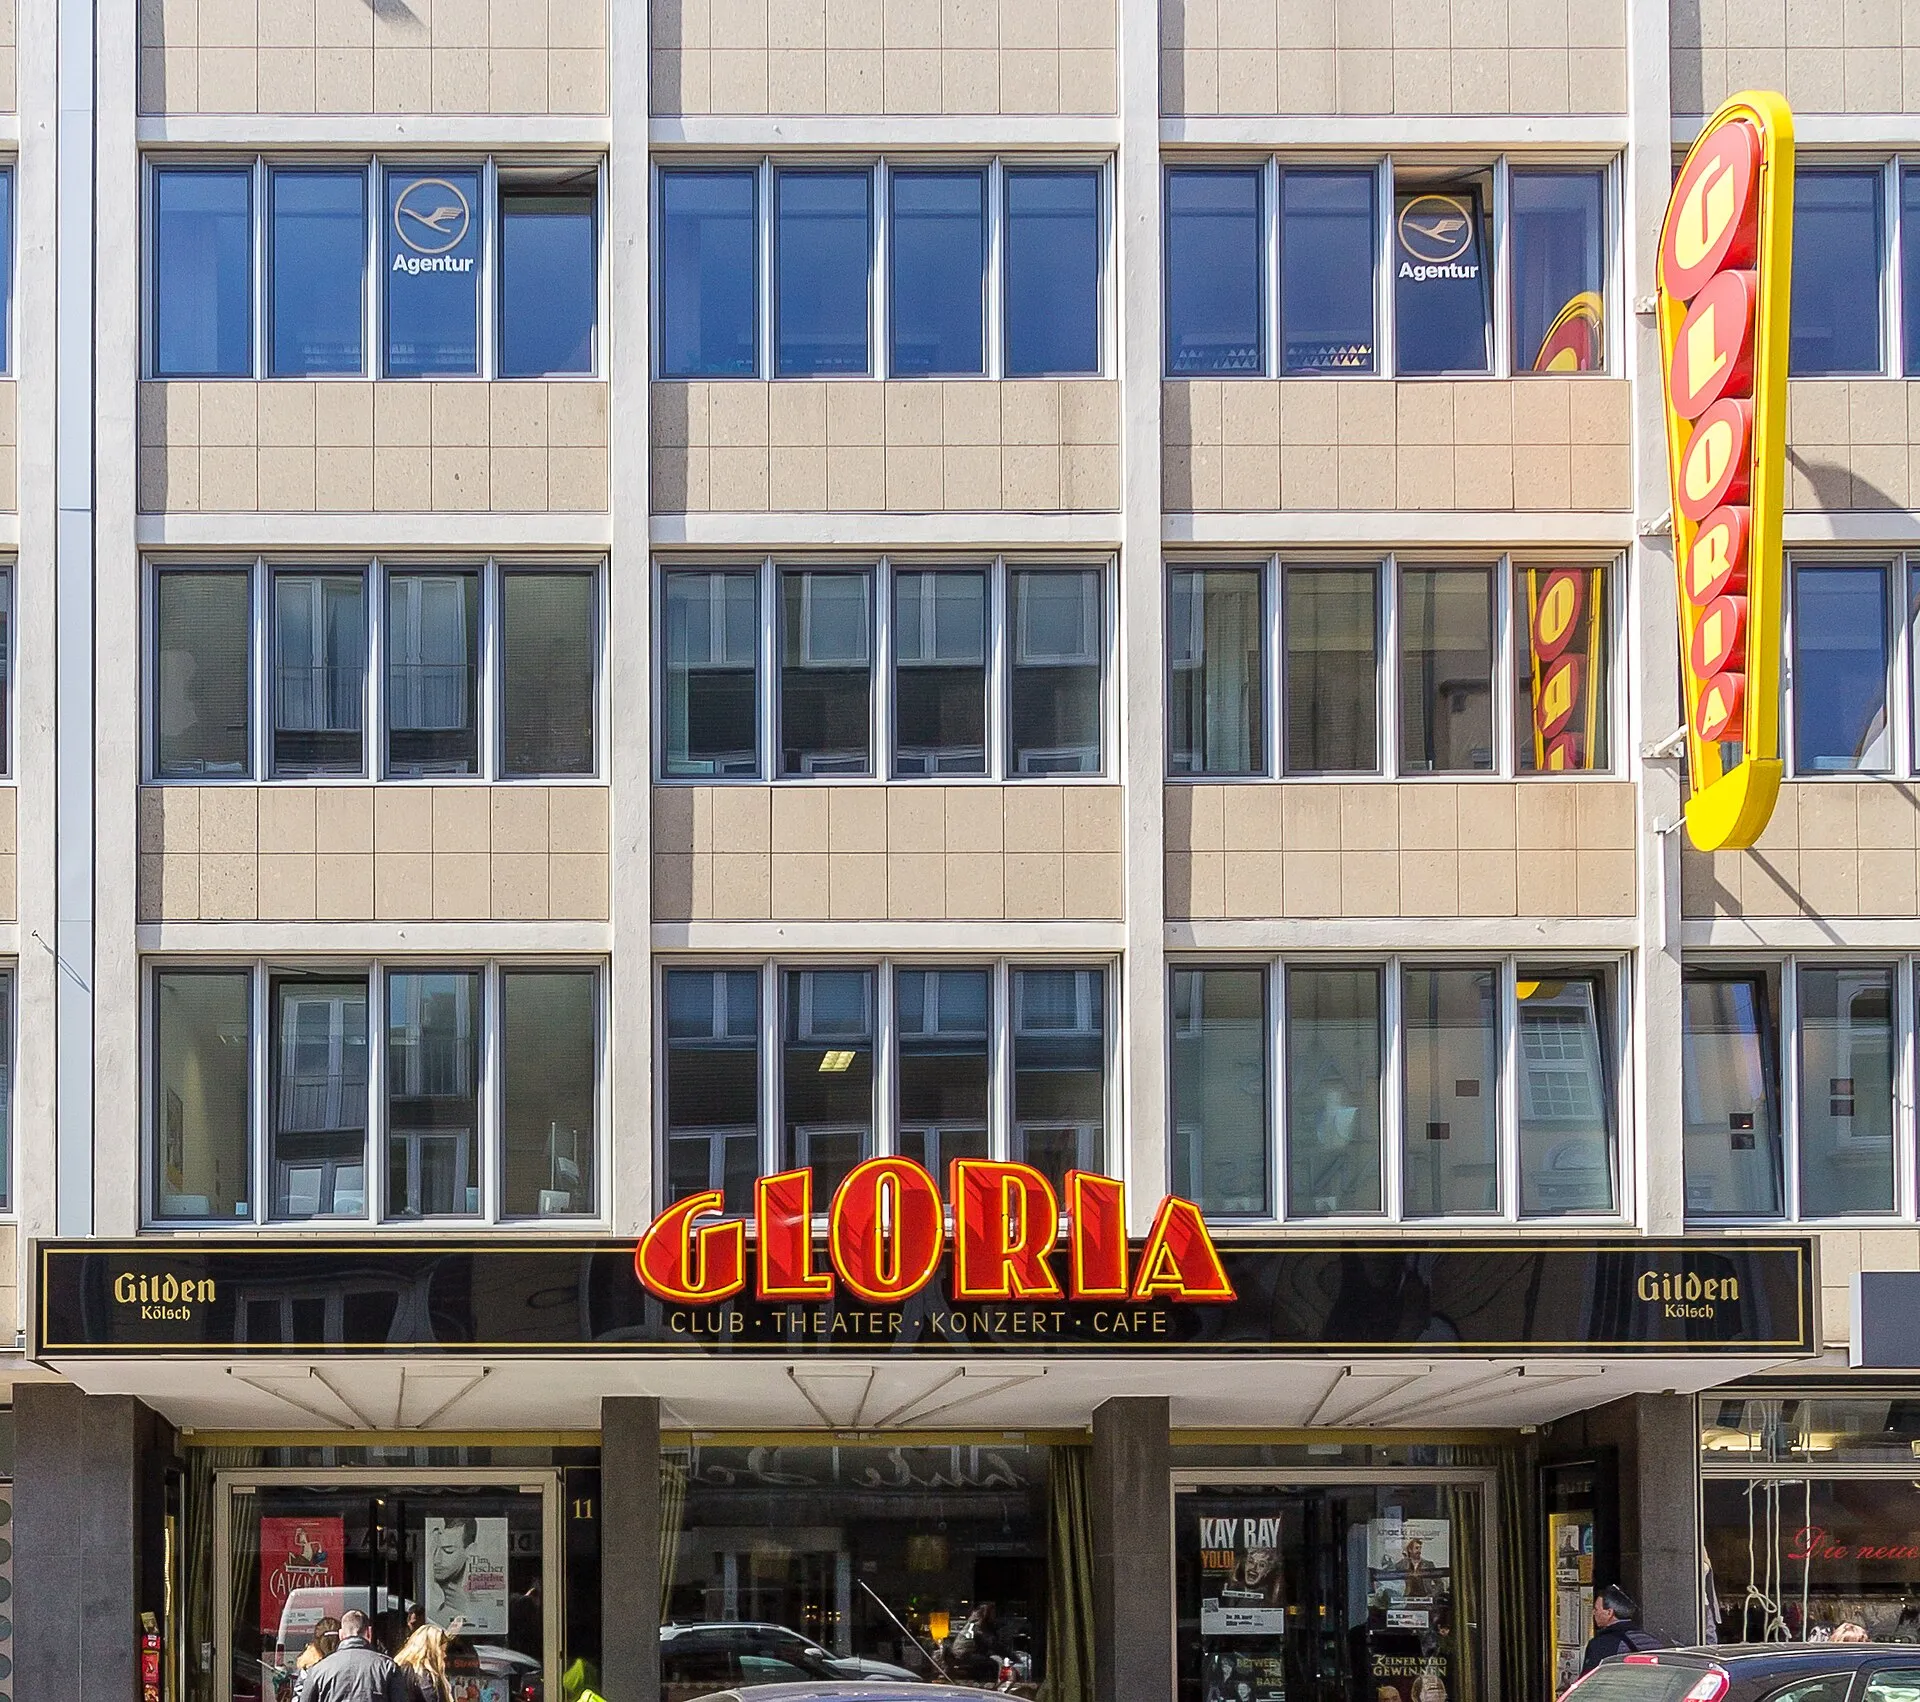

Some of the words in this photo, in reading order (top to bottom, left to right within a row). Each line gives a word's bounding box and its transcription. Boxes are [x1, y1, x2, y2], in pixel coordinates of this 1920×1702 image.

[392, 253, 474, 275] Agentur
[1398, 260, 1479, 283] Agentur
[1673, 155, 1735, 735] GLORIA
[635, 1156, 1237, 1301] GLORIA
[114, 1272, 216, 1304] Gilden
[1637, 1270, 1739, 1301] Gilden
[142, 1305, 191, 1321] Kölsch
[671, 1311, 744, 1334] CLUB
[771, 1311, 903, 1334] THEATER
[932, 1311, 1066, 1334] KONZERT
[1093, 1311, 1167, 1333] CAFE
[1664, 1303, 1714, 1320] Kölsch
[572, 1498, 592, 1520] 11
[1200, 1518, 1238, 1549] KAY
[1243, 1518, 1281, 1549] RAY
[1787, 1526, 1849, 1562] Die
[468, 1562, 504, 1573] Fischer
[469, 1554, 489, 1565] Tim
[1201, 1550, 1235, 1569] YOLO!
[1236, 1658, 1282, 1668] BETWEEN
[1371, 1653, 1416, 1667] KEINER
[1418, 1655, 1447, 1666] WIRD
[1372, 1666, 1447, 1677] GEWINNEN
